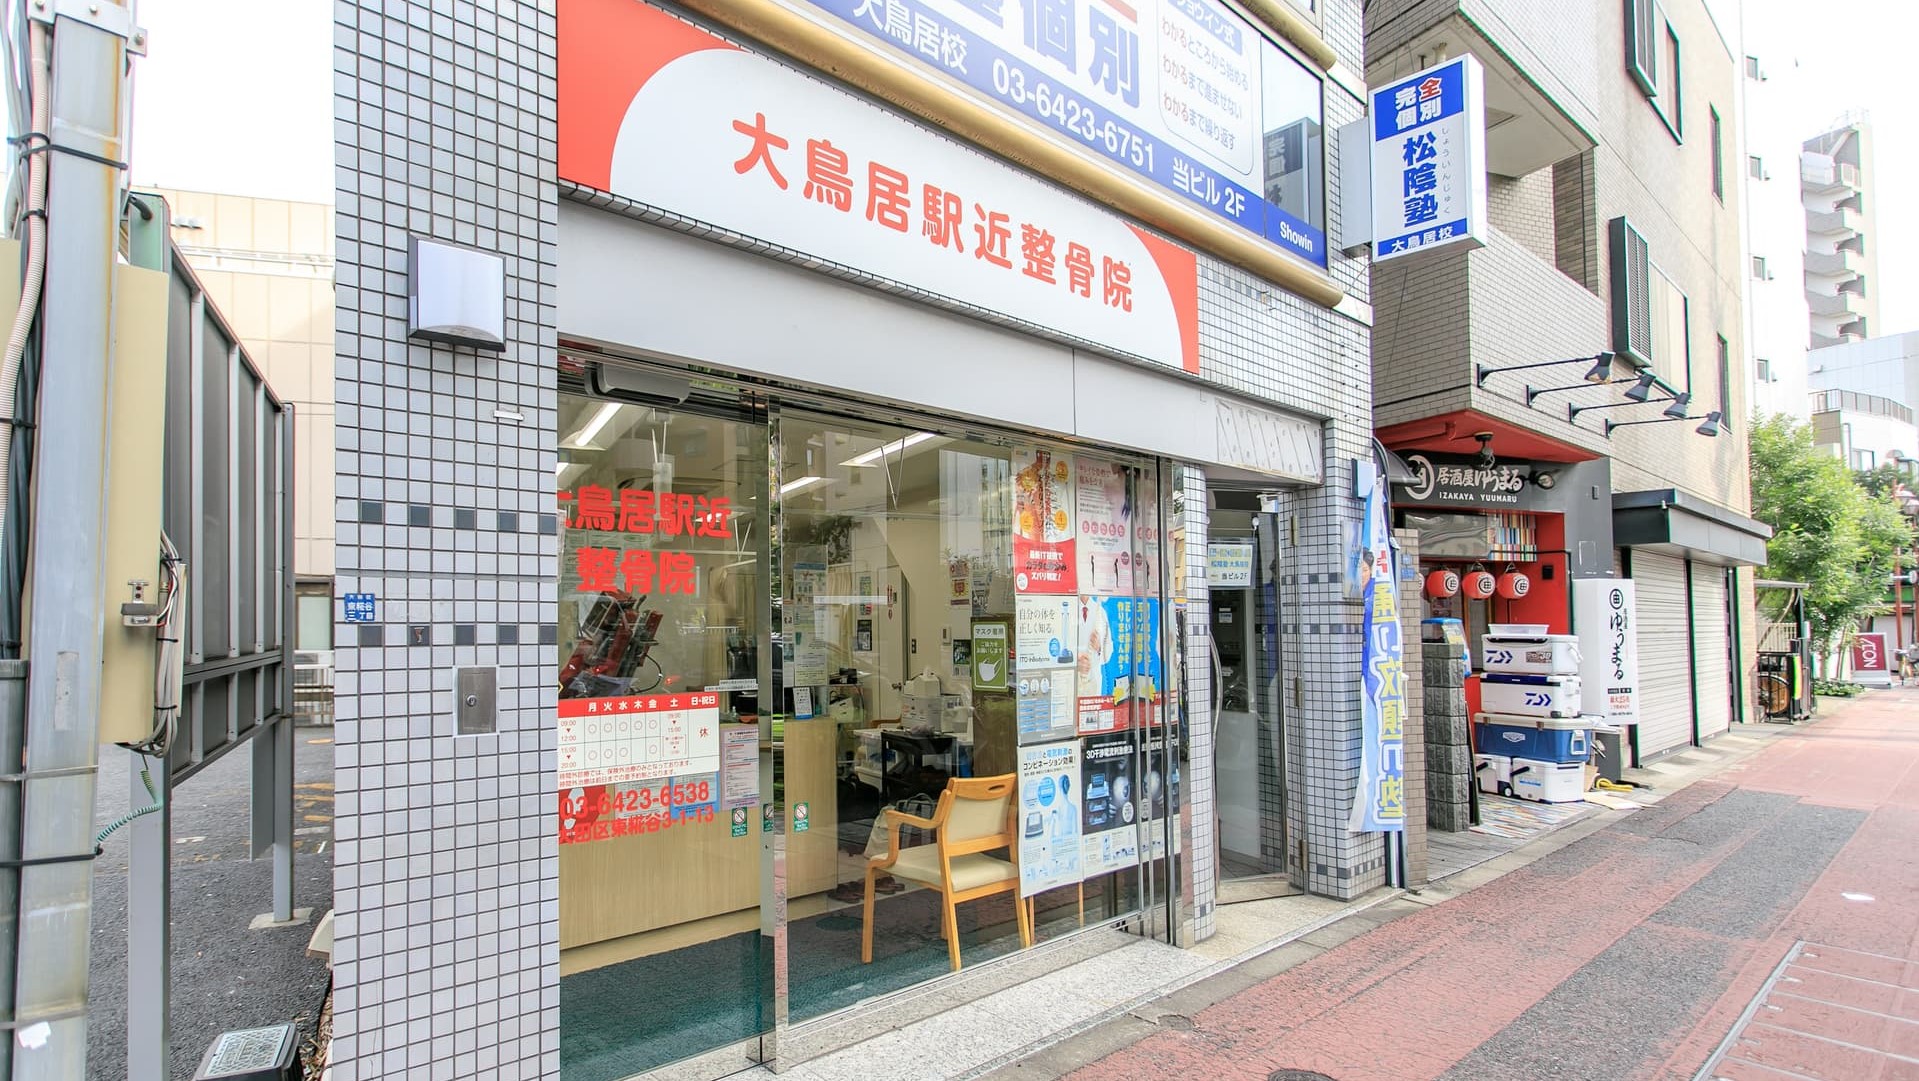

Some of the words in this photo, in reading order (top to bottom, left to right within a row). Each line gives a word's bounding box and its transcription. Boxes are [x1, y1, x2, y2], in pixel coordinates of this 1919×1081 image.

[1177, 0, 1236, 47] ョウイン式
[1163, 55, 1242, 120] わかるまで進ませない
[1395, 77, 1442, 110] 完全
[853, 0, 967, 75] 大鳥居校
[992, 58, 1156, 173] 03-6423-6751
[1173, 157, 1221, 206] 当ビル
[1225, 187, 1246, 218] 2F
[1164, 92, 1235, 150] わかるまで繰り返す
[1395, 102, 1442, 131] 個別
[1403, 131, 1438, 228] 松陰塾
[1441, 127, 1451, 214] しょういんじゅく
[732, 112, 1133, 313] 大鳥居駅近整骨院
[1280, 221, 1313, 253] Showin
[1391, 226, 1453, 254] 大鳥居校
[1436, 465, 1523, 492] 居酒屋ゆうまる
[1439, 492, 1474, 500] IZAKAYA
[1480, 494, 1517, 503] YUUMARU
[575, 545, 696, 596] 整骨院
[1019, 608, 1055, 620] 自分の体を
[1610, 612, 1625, 680] ゆうまる
[588, 702, 597, 712] 月
[603, 702, 612, 711] 火
[618, 701, 628, 710] 水
[634, 700, 643, 709] 木
[648, 699, 657, 708] 金
[670, 698, 678, 708] 土
[699, 727, 709, 738] 休
[560, 780, 710, 820] 03-6423-6538
